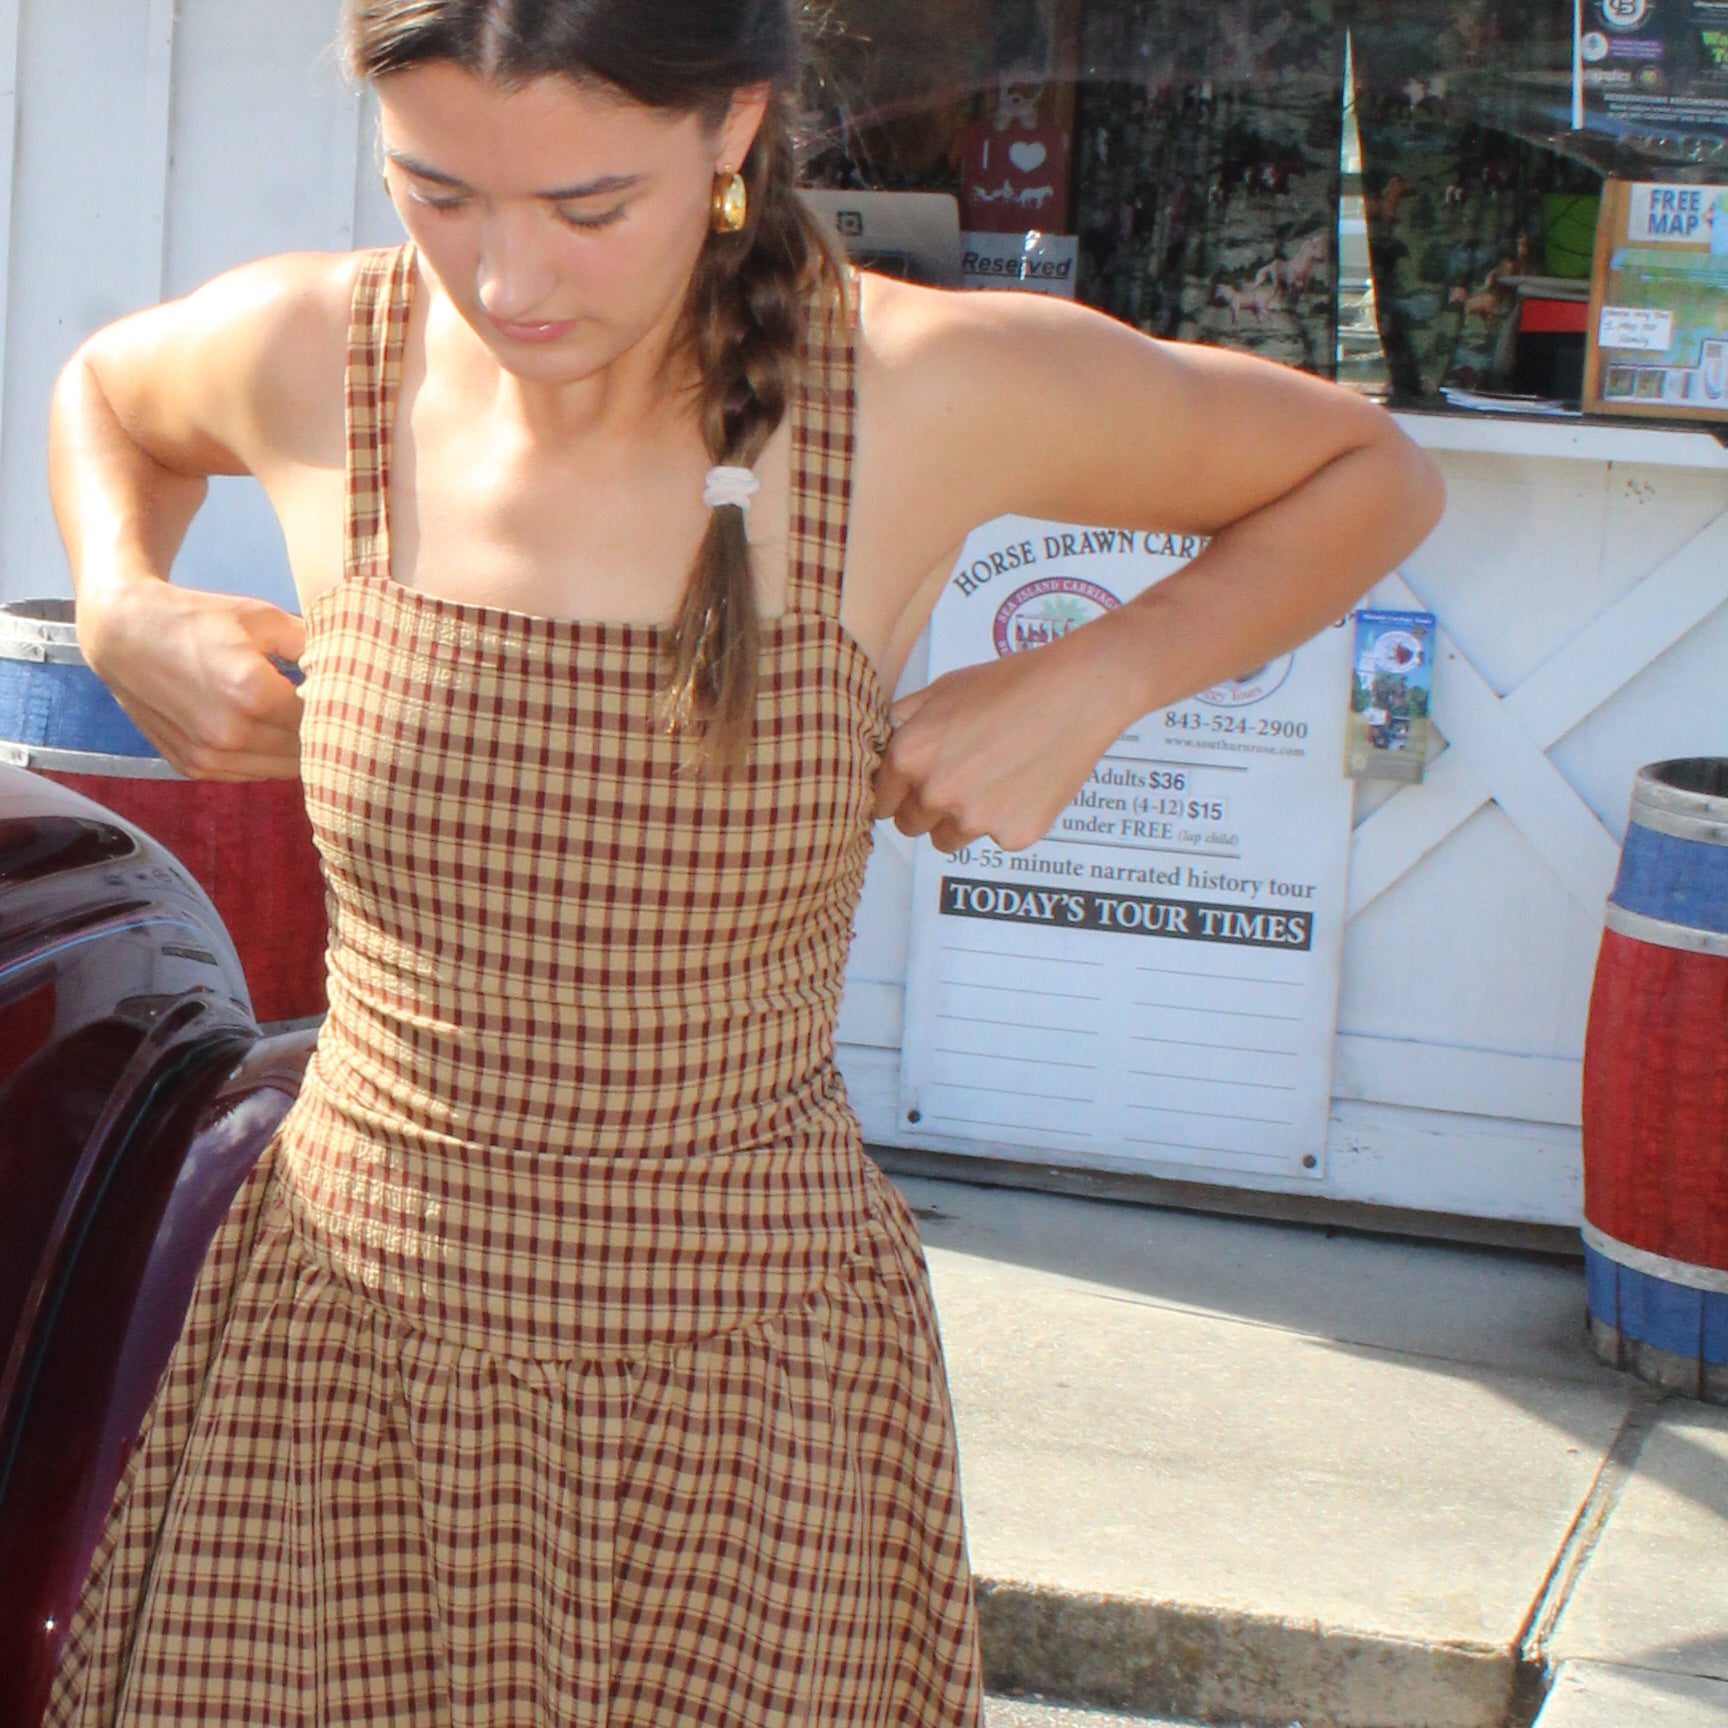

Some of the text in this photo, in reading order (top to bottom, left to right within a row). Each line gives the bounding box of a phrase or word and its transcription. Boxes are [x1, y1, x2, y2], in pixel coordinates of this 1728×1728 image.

[1650, 188, 1702, 212] FREE
[1648, 212, 1700, 236] MAP
[961, 251, 1072, 278] Reseved
[952, 540, 1036, 597] HORSE
[1043, 530, 1135, 560] DRAWN
[1164, 710, 1308, 739] 843-524-2900
[1088, 768, 1186, 791] Adults $36
[1072, 790, 1223, 821] ildren (4-12) $15
[1062, 815, 1116, 836] under
[1121, 819, 1173, 841] FREE
[1009, 854, 1084, 878] minute
[1090, 862, 1181, 887] narrated
[1187, 866, 1263, 900] history
[1269, 878, 1317, 900] tour
[949, 881, 1307, 946] TODAY'S TOUR TIMES
